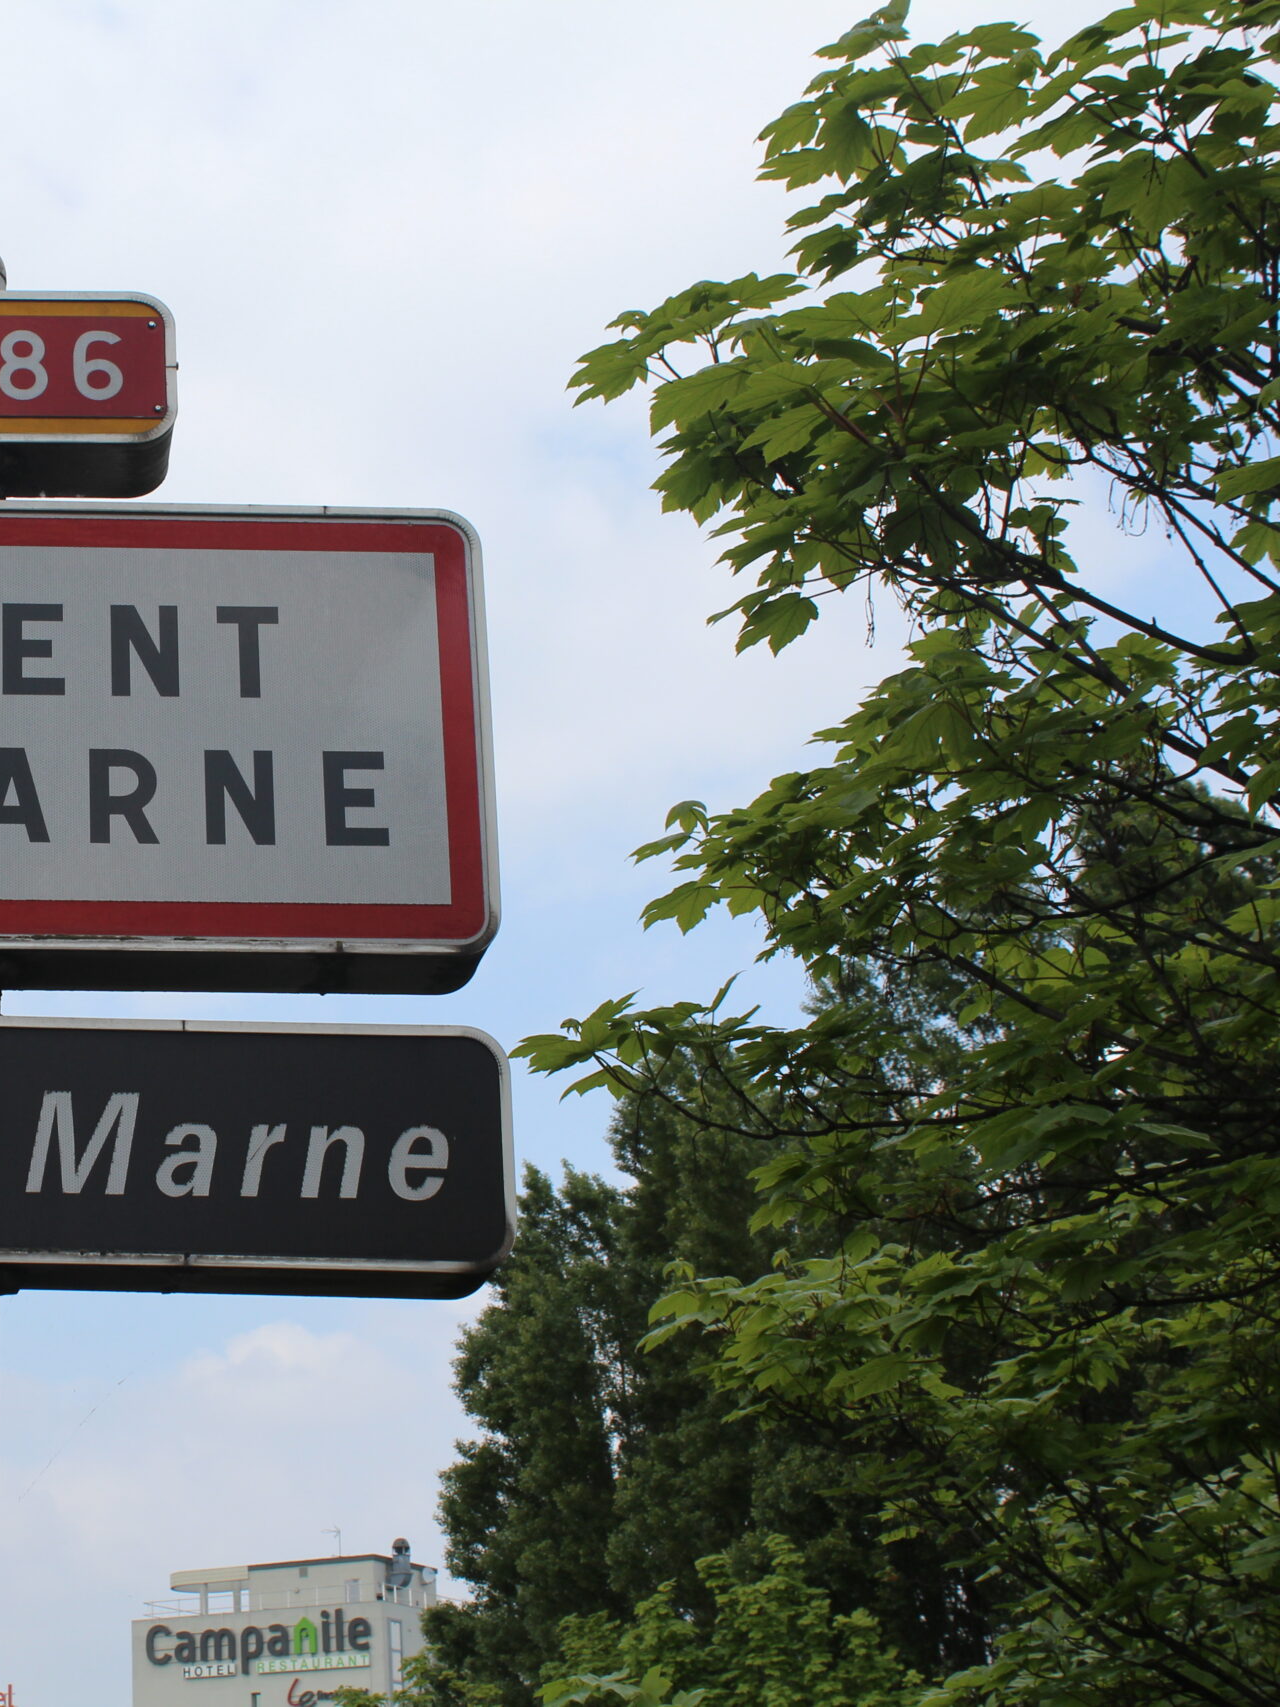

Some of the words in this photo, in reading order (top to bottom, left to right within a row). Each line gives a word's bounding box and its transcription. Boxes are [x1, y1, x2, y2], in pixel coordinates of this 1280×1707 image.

[25, 1090, 450, 1201] Marne
[146, 1608, 372, 1676] Campanile
[182, 1664, 235, 1678] HOTEL
[255, 1654, 370, 1673] RESTAURANT
